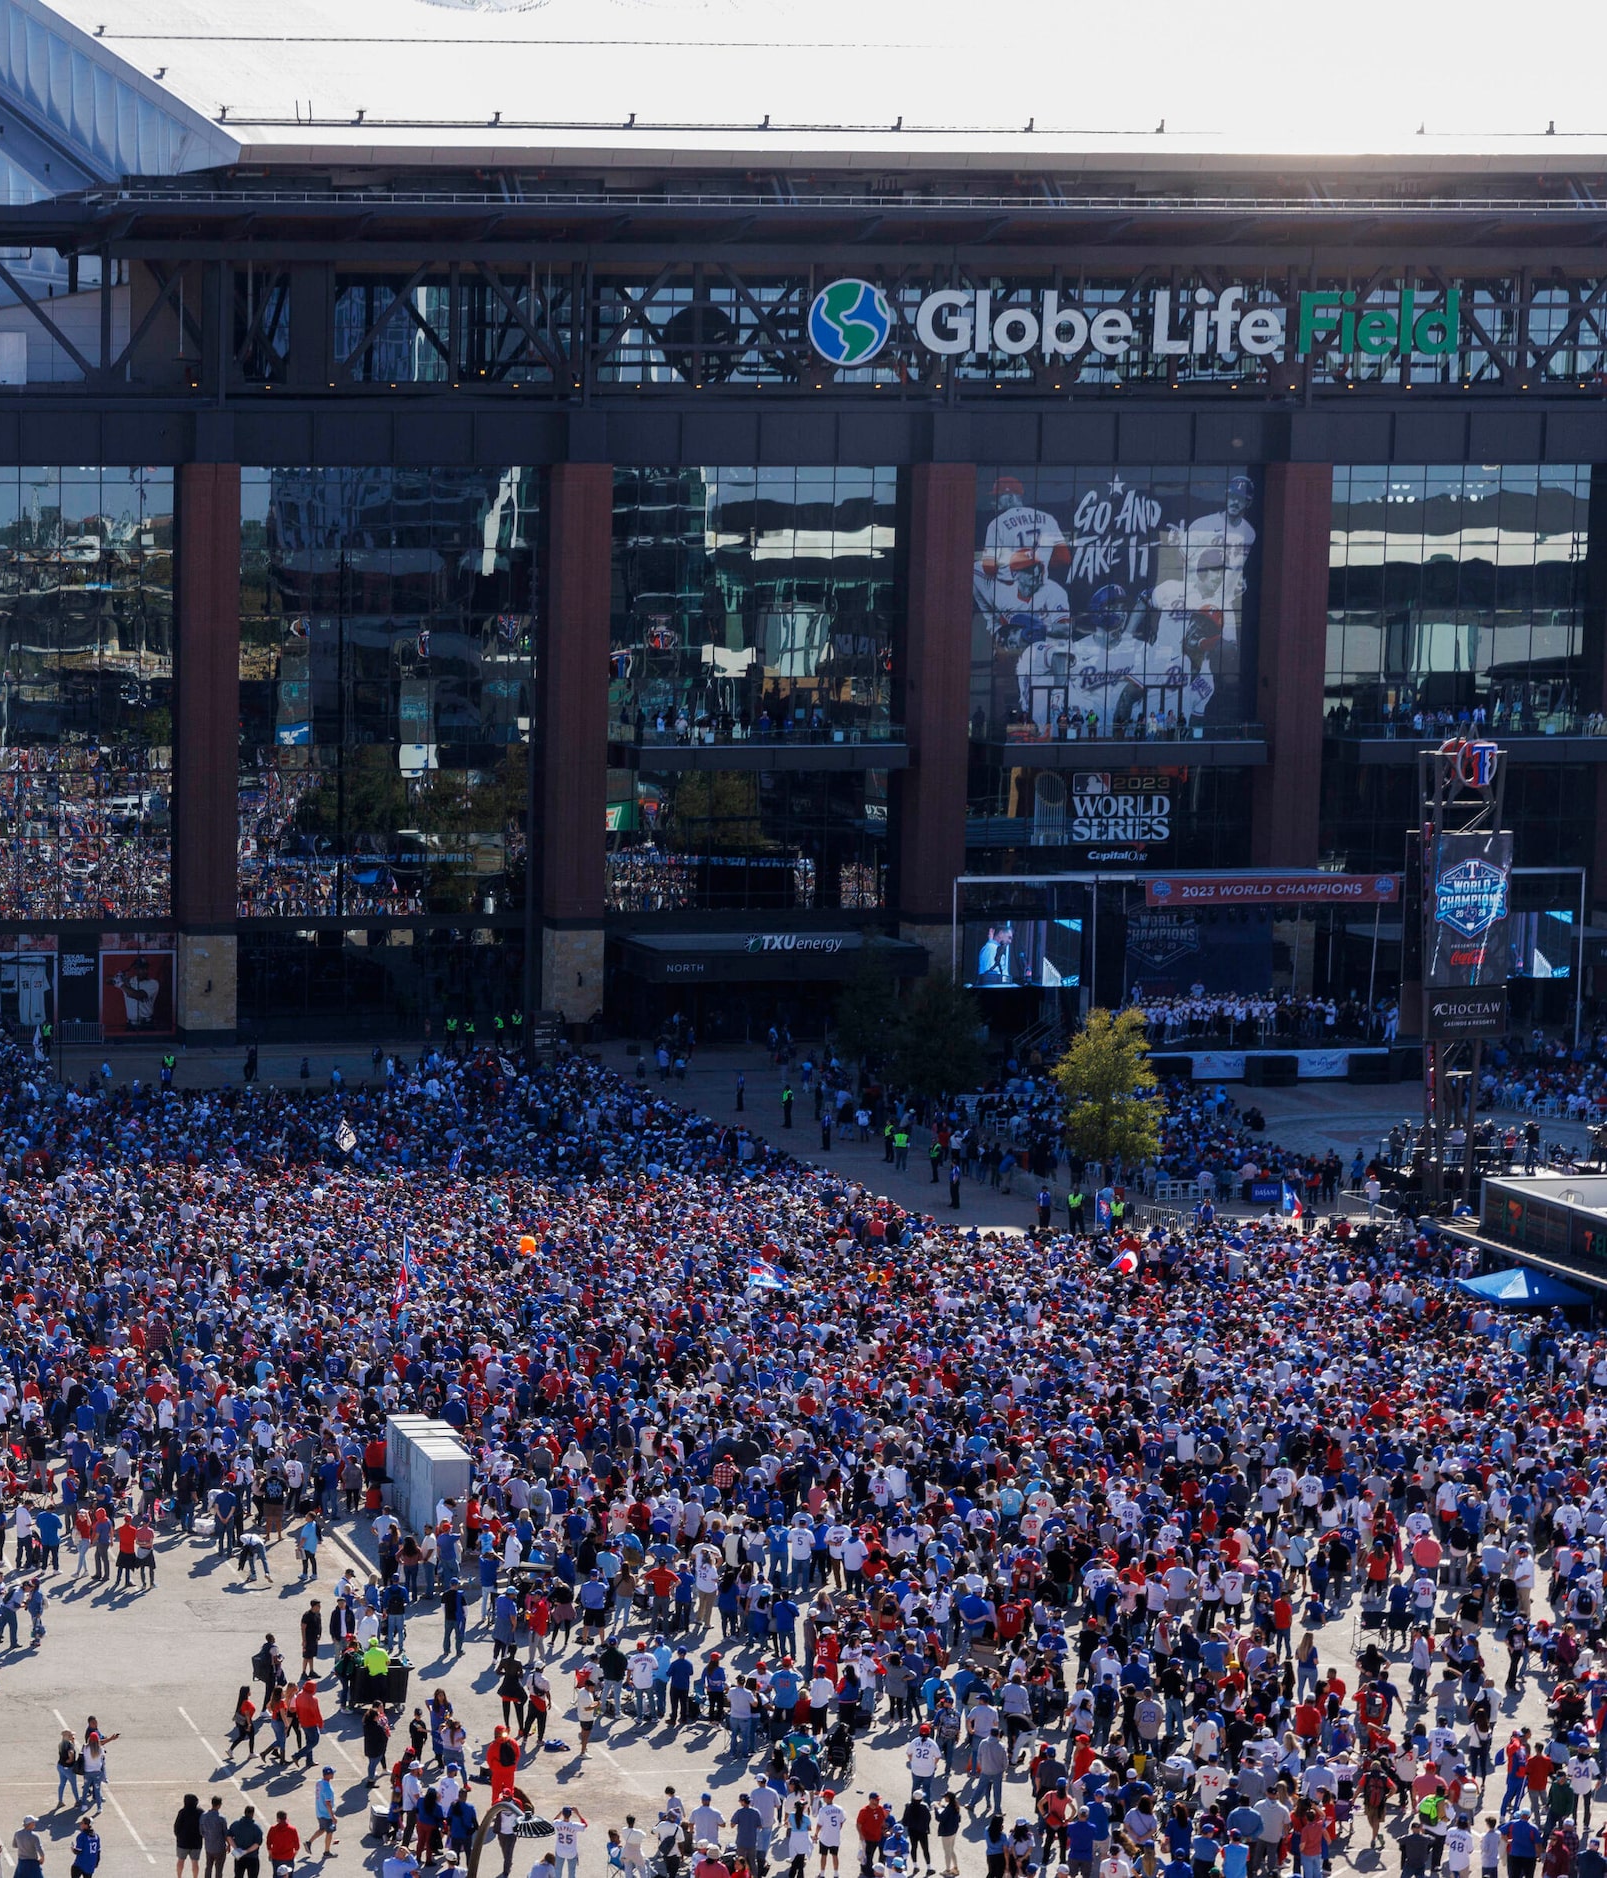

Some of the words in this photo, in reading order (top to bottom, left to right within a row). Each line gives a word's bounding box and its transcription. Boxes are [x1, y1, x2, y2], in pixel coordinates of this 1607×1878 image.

[916, 289, 1133, 355] Globe
[1153, 286, 1281, 355] Life
[1299, 288, 1460, 355] Field
[1074, 490, 1112, 535] GO
[1114, 489, 1162, 534] AND
[1066, 536, 1124, 584] TAKE
[1128, 536, 1162, 584] IT
[1114, 777, 1170, 789] 2023
[1072, 795, 1171, 817] WORLD
[1072, 817, 1170, 841] SERIES
[1182, 886, 1215, 897] 2023
[1219, 884, 1271, 896] WORLD
[1274, 883, 1362, 895] CHAMPIONS
[1454, 879, 1491, 894] WORLD
[1439, 894, 1503, 911] CHAMPIONS
[762, 935, 796, 950] TXU
[796, 938, 842, 953] energy
[666, 964, 704, 973] NORTH
[1439, 1002, 1501, 1015] CHOCTAW
[1255, 1188, 1277, 1197] DASANI
[1150, 1449, 1156, 1457] 11
[875, 1485, 884, 1494] 31
[1305, 1485, 1316, 1493] 32
[1123, 1510, 1133, 1519] 48
[1567, 1515, 1572, 1523] 5
[1416, 1521, 1421, 1529] 5
[1342, 1531, 1353, 1539] 42
[798, 1537, 803, 1545] 5
[1205, 1582, 1215, 1592] 34
[1230, 1582, 1236, 1591] 7
[1420, 1588, 1430, 1596] 31
[936, 1601, 942, 1609] 5
[1007, 1613, 1013, 1622] 11
[819, 1647, 828, 1656] 12
[641, 1663, 647, 1672] 7
[1142, 1711, 1155, 1722] 29
[916, 1749, 929, 1759] 32
[1574, 1766, 1589, 1778] 34
[831, 1816, 837, 1826] 5
[559, 1833, 573, 1844] 25
[90, 1842, 96, 1853] 13
[1450, 1841, 1464, 1852] 48
